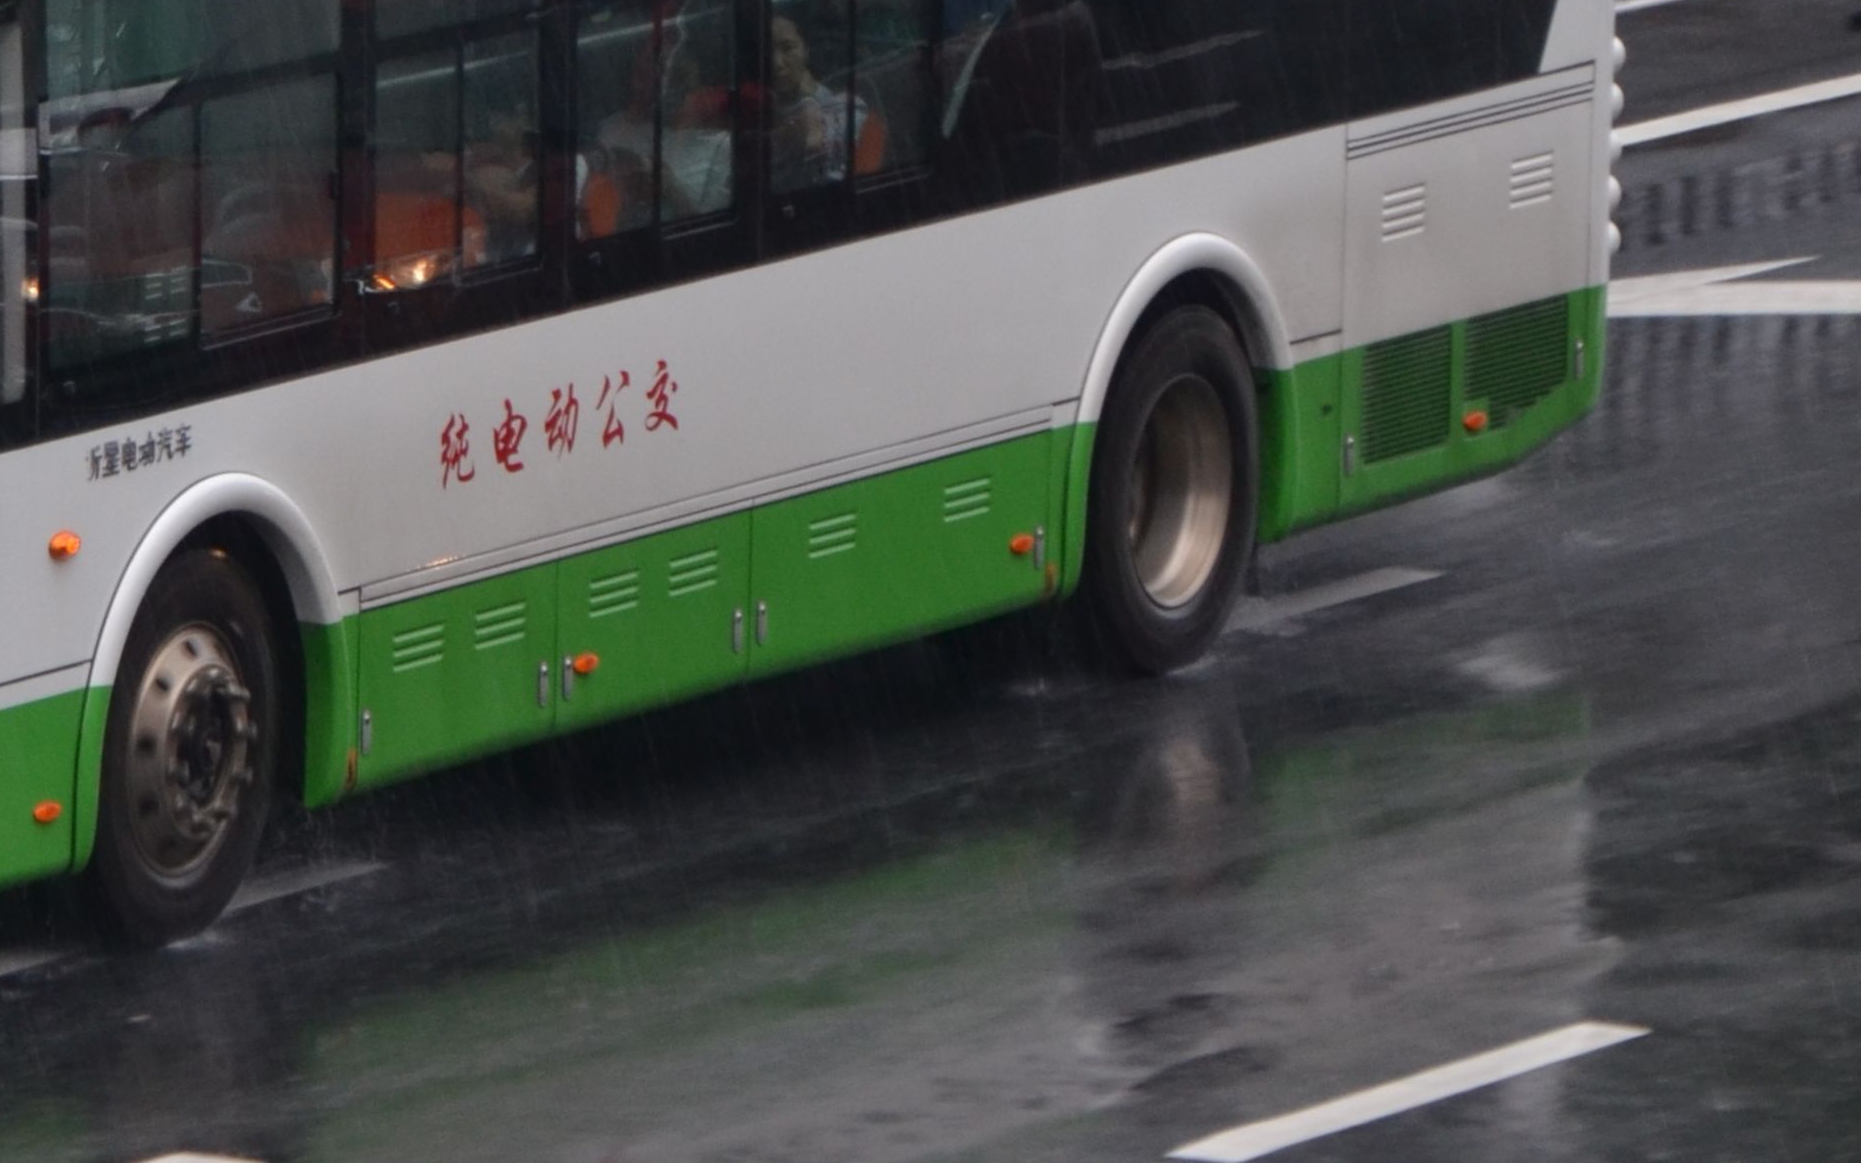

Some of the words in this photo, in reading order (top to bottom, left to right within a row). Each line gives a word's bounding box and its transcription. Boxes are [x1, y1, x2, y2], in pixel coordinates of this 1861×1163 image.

[440, 358, 680, 490] 纯电动公交
